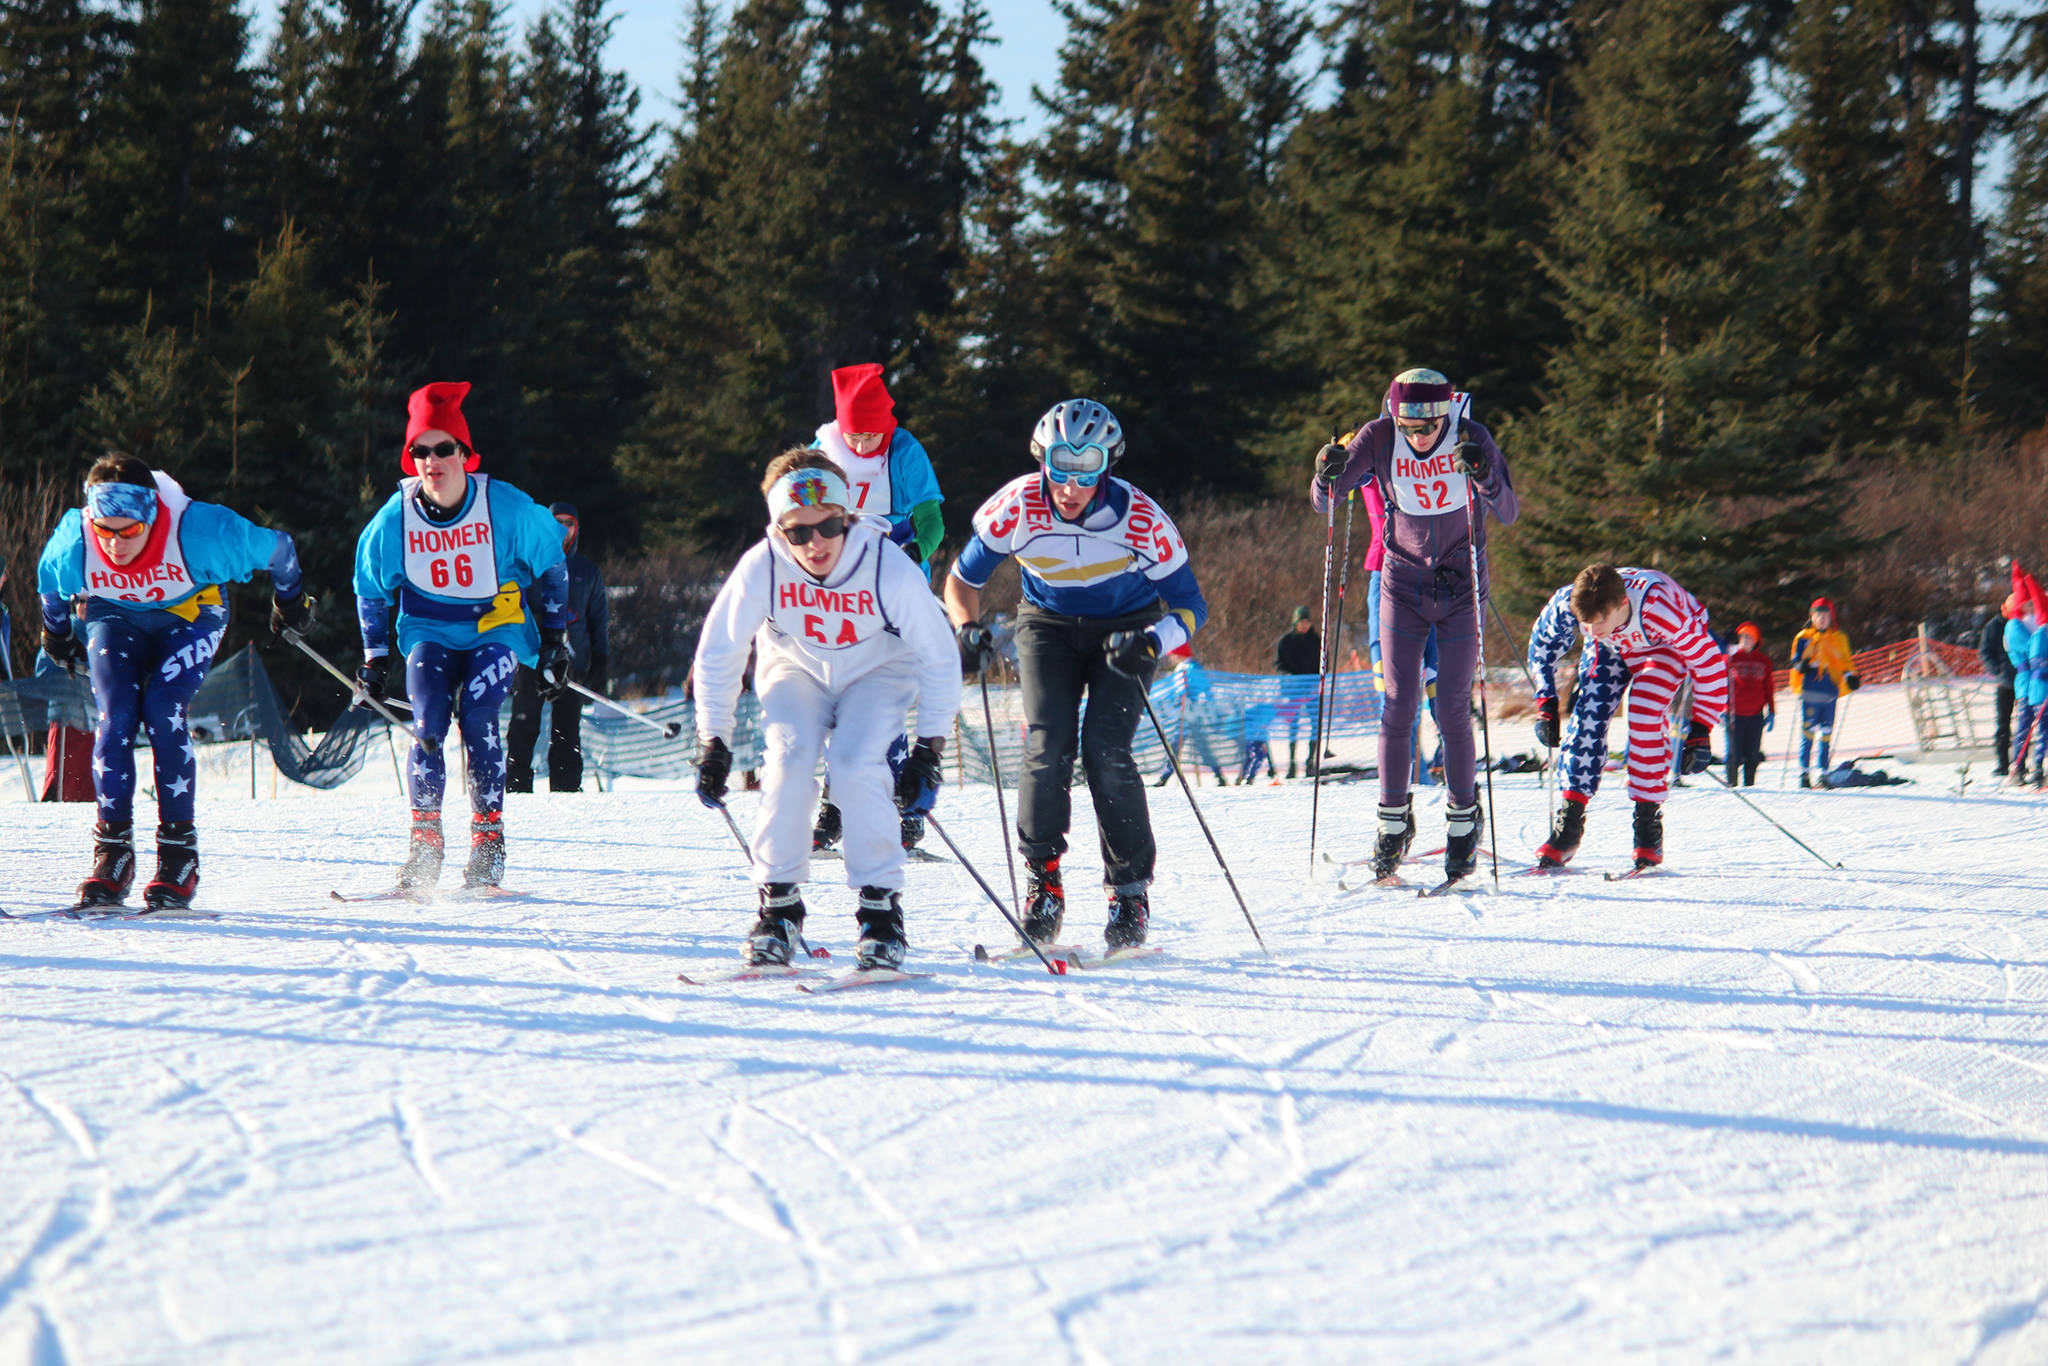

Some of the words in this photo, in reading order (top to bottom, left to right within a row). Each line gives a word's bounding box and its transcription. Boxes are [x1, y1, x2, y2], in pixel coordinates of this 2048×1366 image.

[1413, 480, 1452, 510] 52
[408, 522, 490, 554] HOMER
[90, 562, 185, 590] HOMER
[430, 553, 474, 589] 66
[780, 581, 876, 617] HOMER
